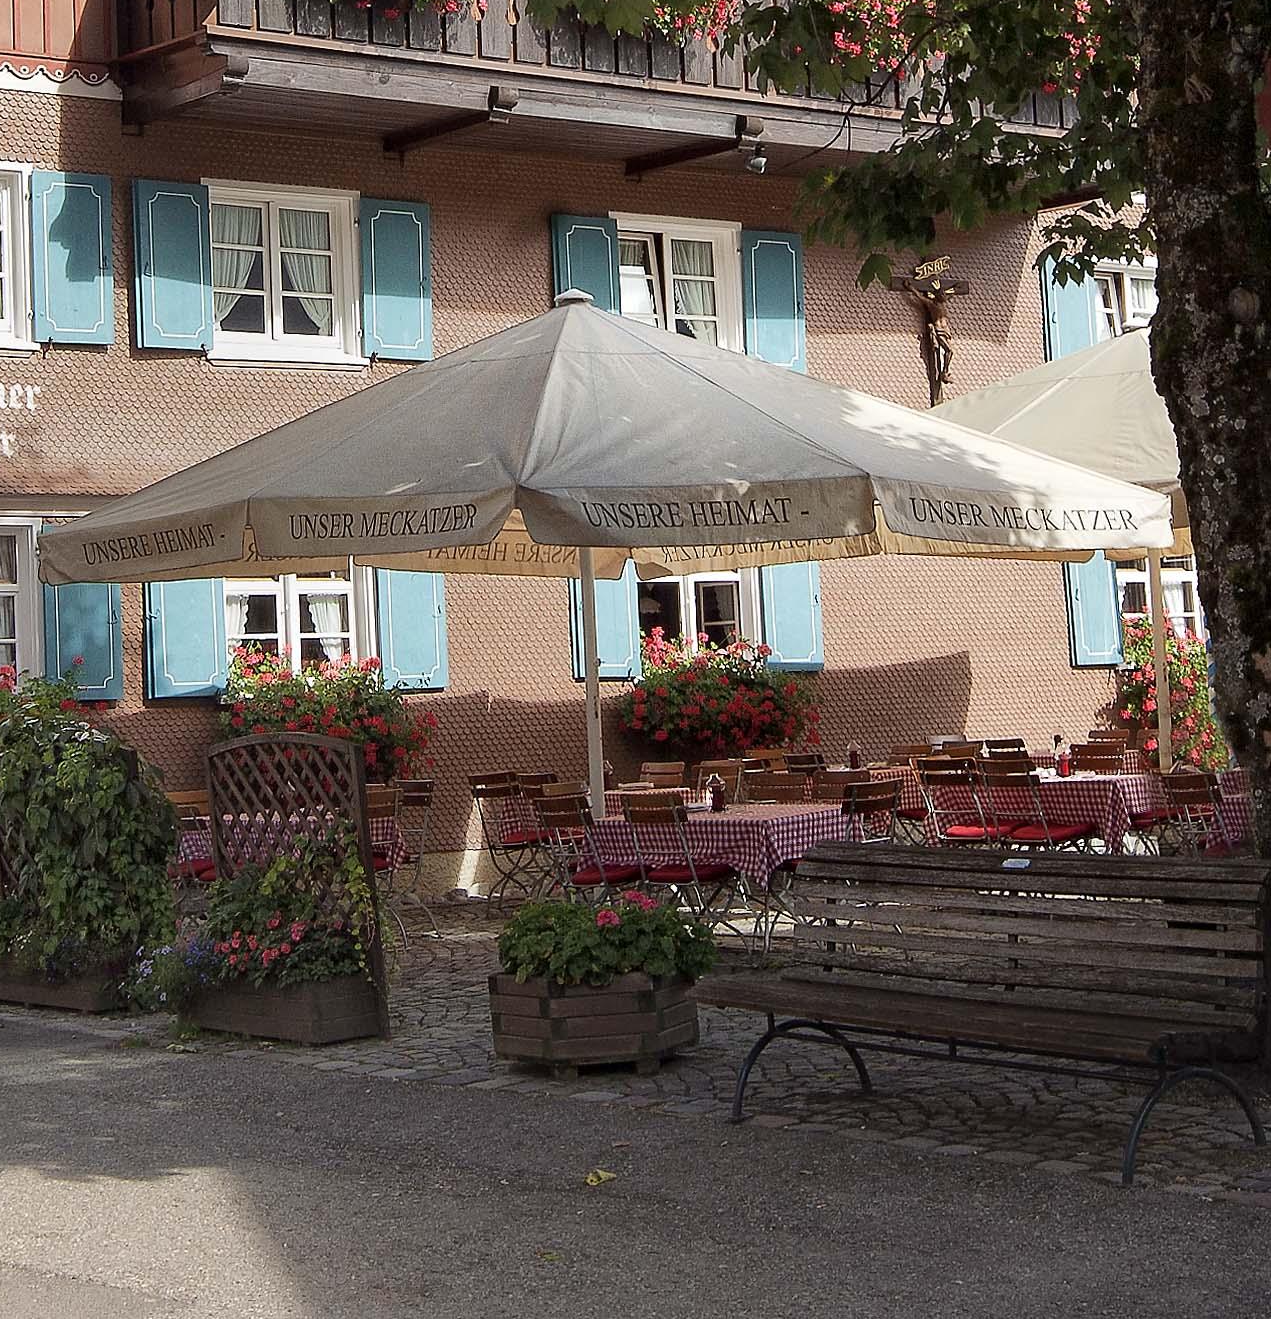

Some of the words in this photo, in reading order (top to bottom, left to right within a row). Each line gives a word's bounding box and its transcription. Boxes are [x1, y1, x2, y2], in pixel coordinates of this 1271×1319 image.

[289, 512, 354, 540] UNSER
[359, 503, 478, 538] MECKATZER
[581, 501, 685, 528] UNSERE
[688, 498, 792, 527] HEIMAT
[909, 497, 989, 527] UNSER
[990, 504, 1139, 531] MECKATZER
[82, 534, 152, 566] UNSERE
[152, 523, 216, 555] HEIMAT
